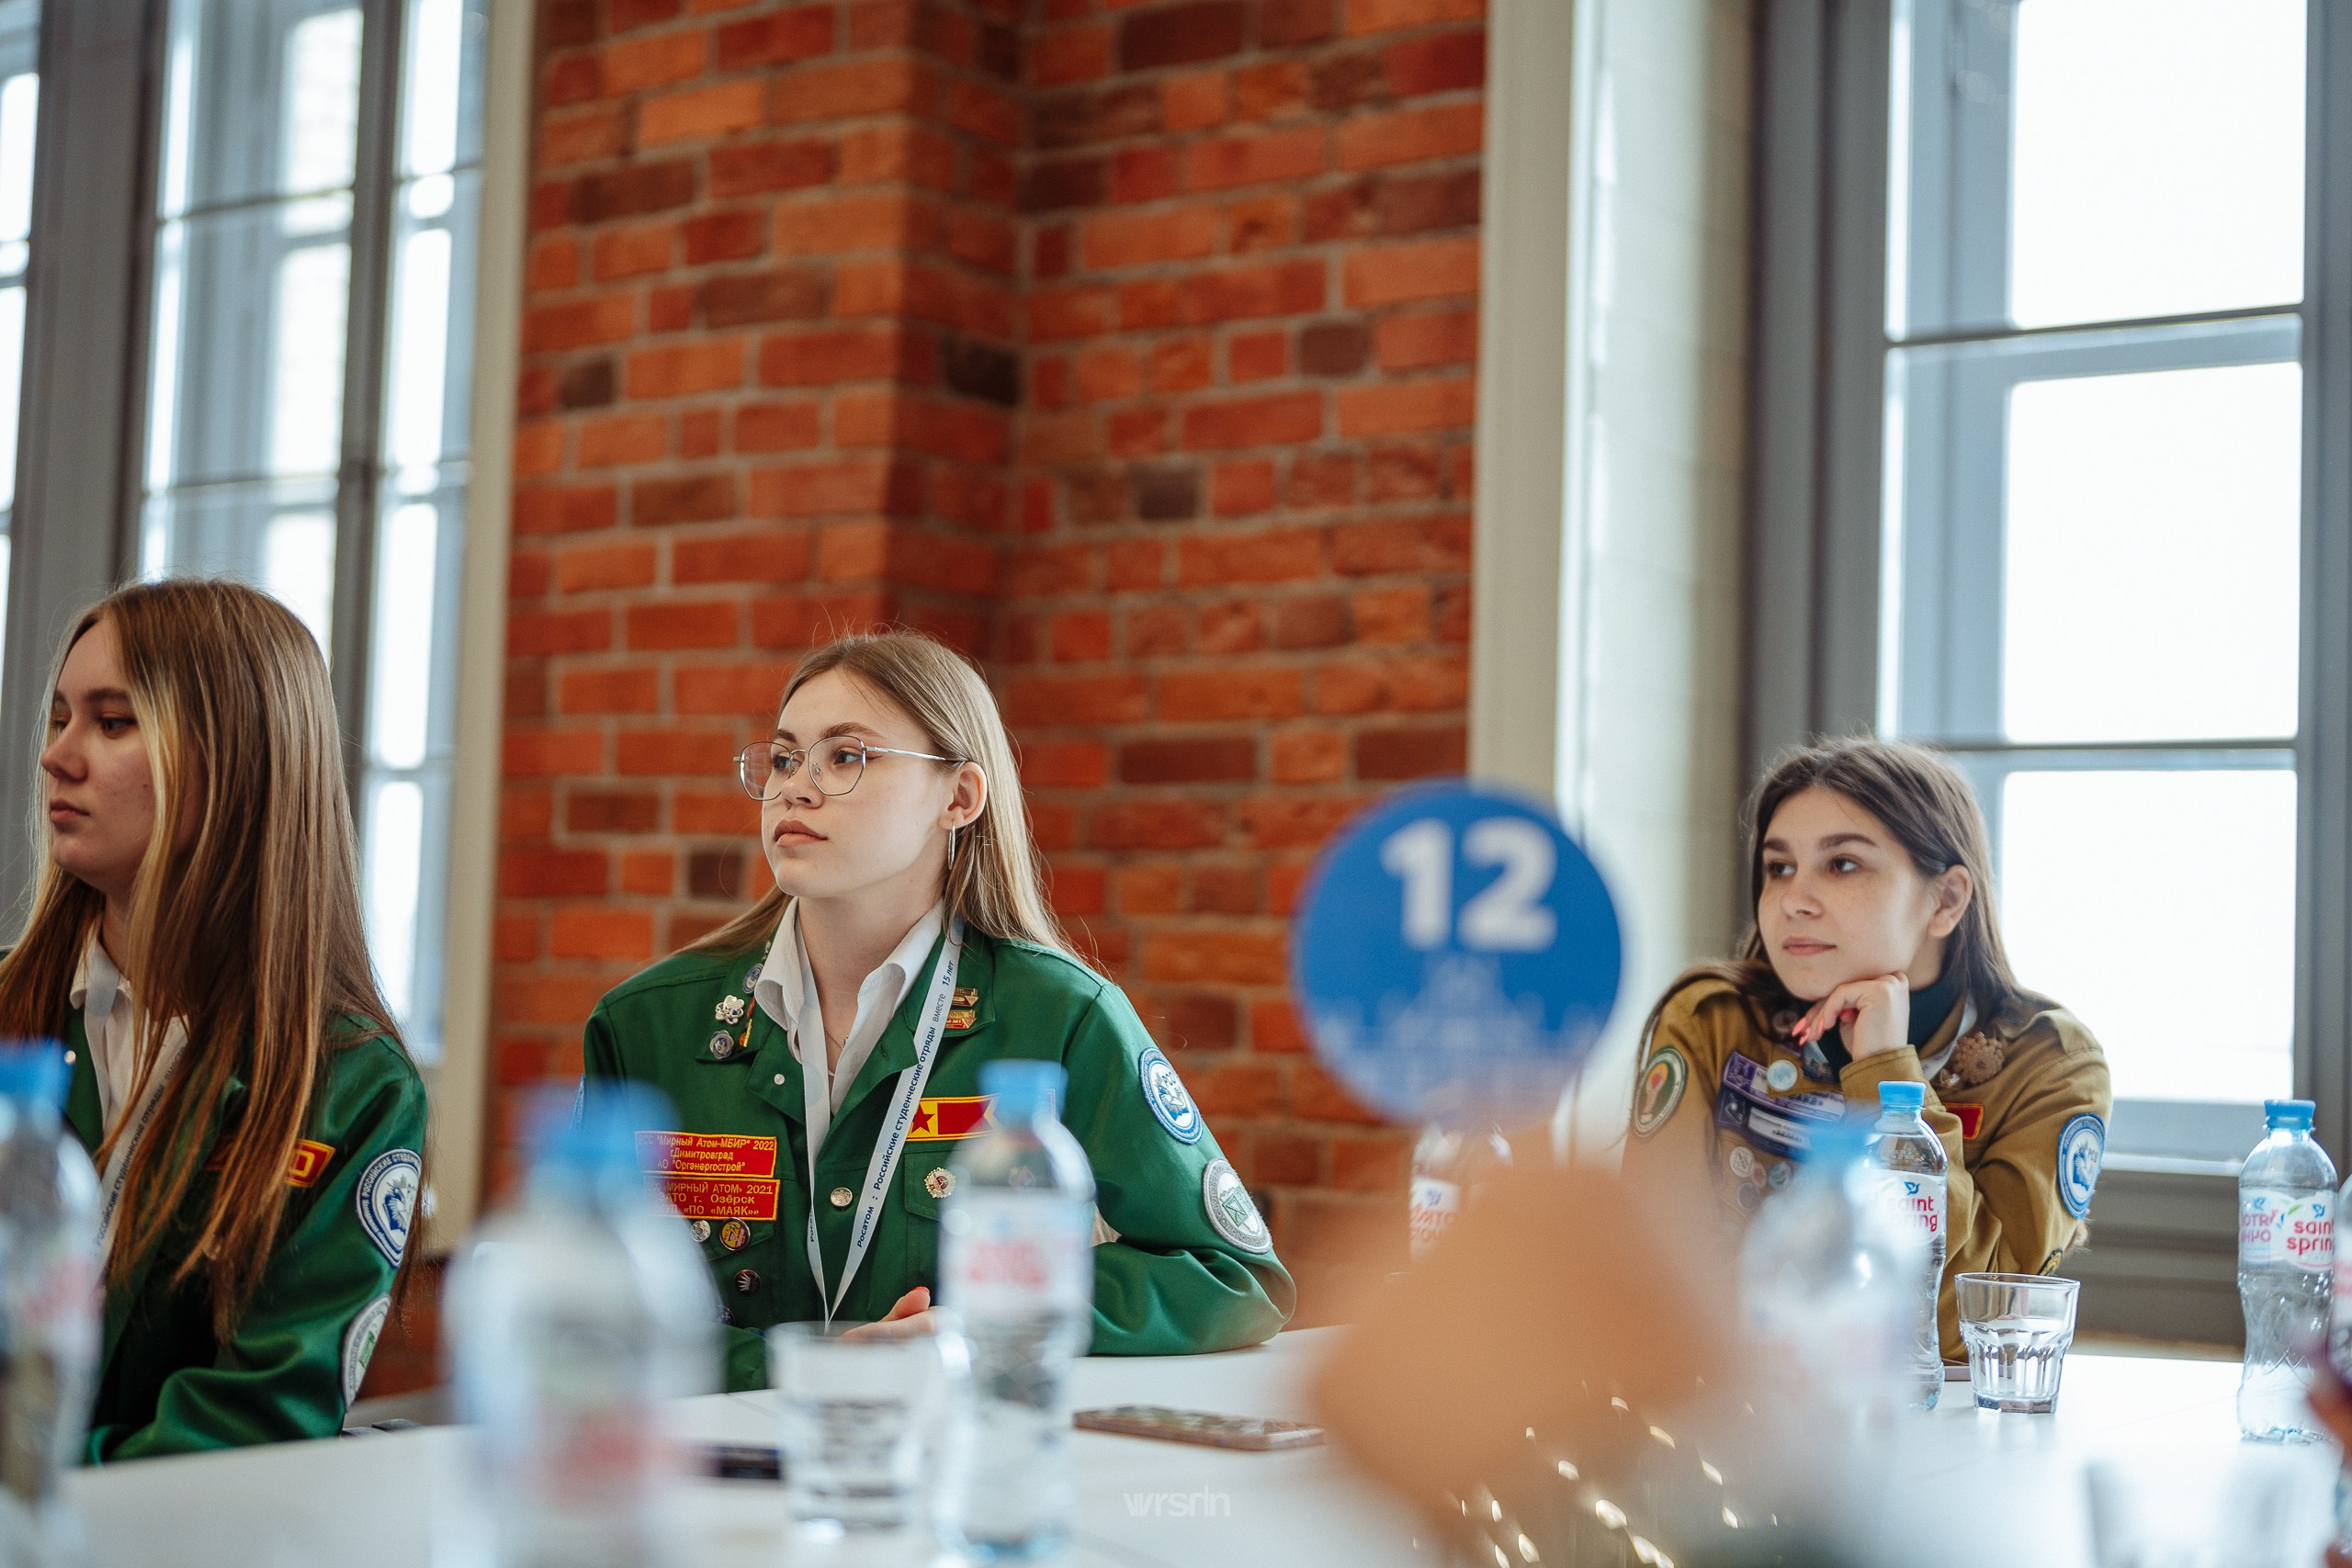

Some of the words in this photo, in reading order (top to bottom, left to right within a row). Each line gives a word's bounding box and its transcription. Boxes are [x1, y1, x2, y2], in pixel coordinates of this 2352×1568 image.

[1381, 816, 1558, 953] 12
[856, 1206, 875, 1247] Росатом
[874, 1132, 899, 1190] Российские
[896, 1064, 923, 1131] студенческие
[920, 1026, 936, 1063] отряды
[933, 993, 946, 1022] вместе
[942, 975, 951, 986] 15
[752, 1140, 774, 1151] 2022
[746, 1185, 773, 1195] 2021
[710, 1194, 755, 1205] Озёрск
[684, 1205, 704, 1214] «ПО
[2287, 1236, 2335, 1256] sprin
